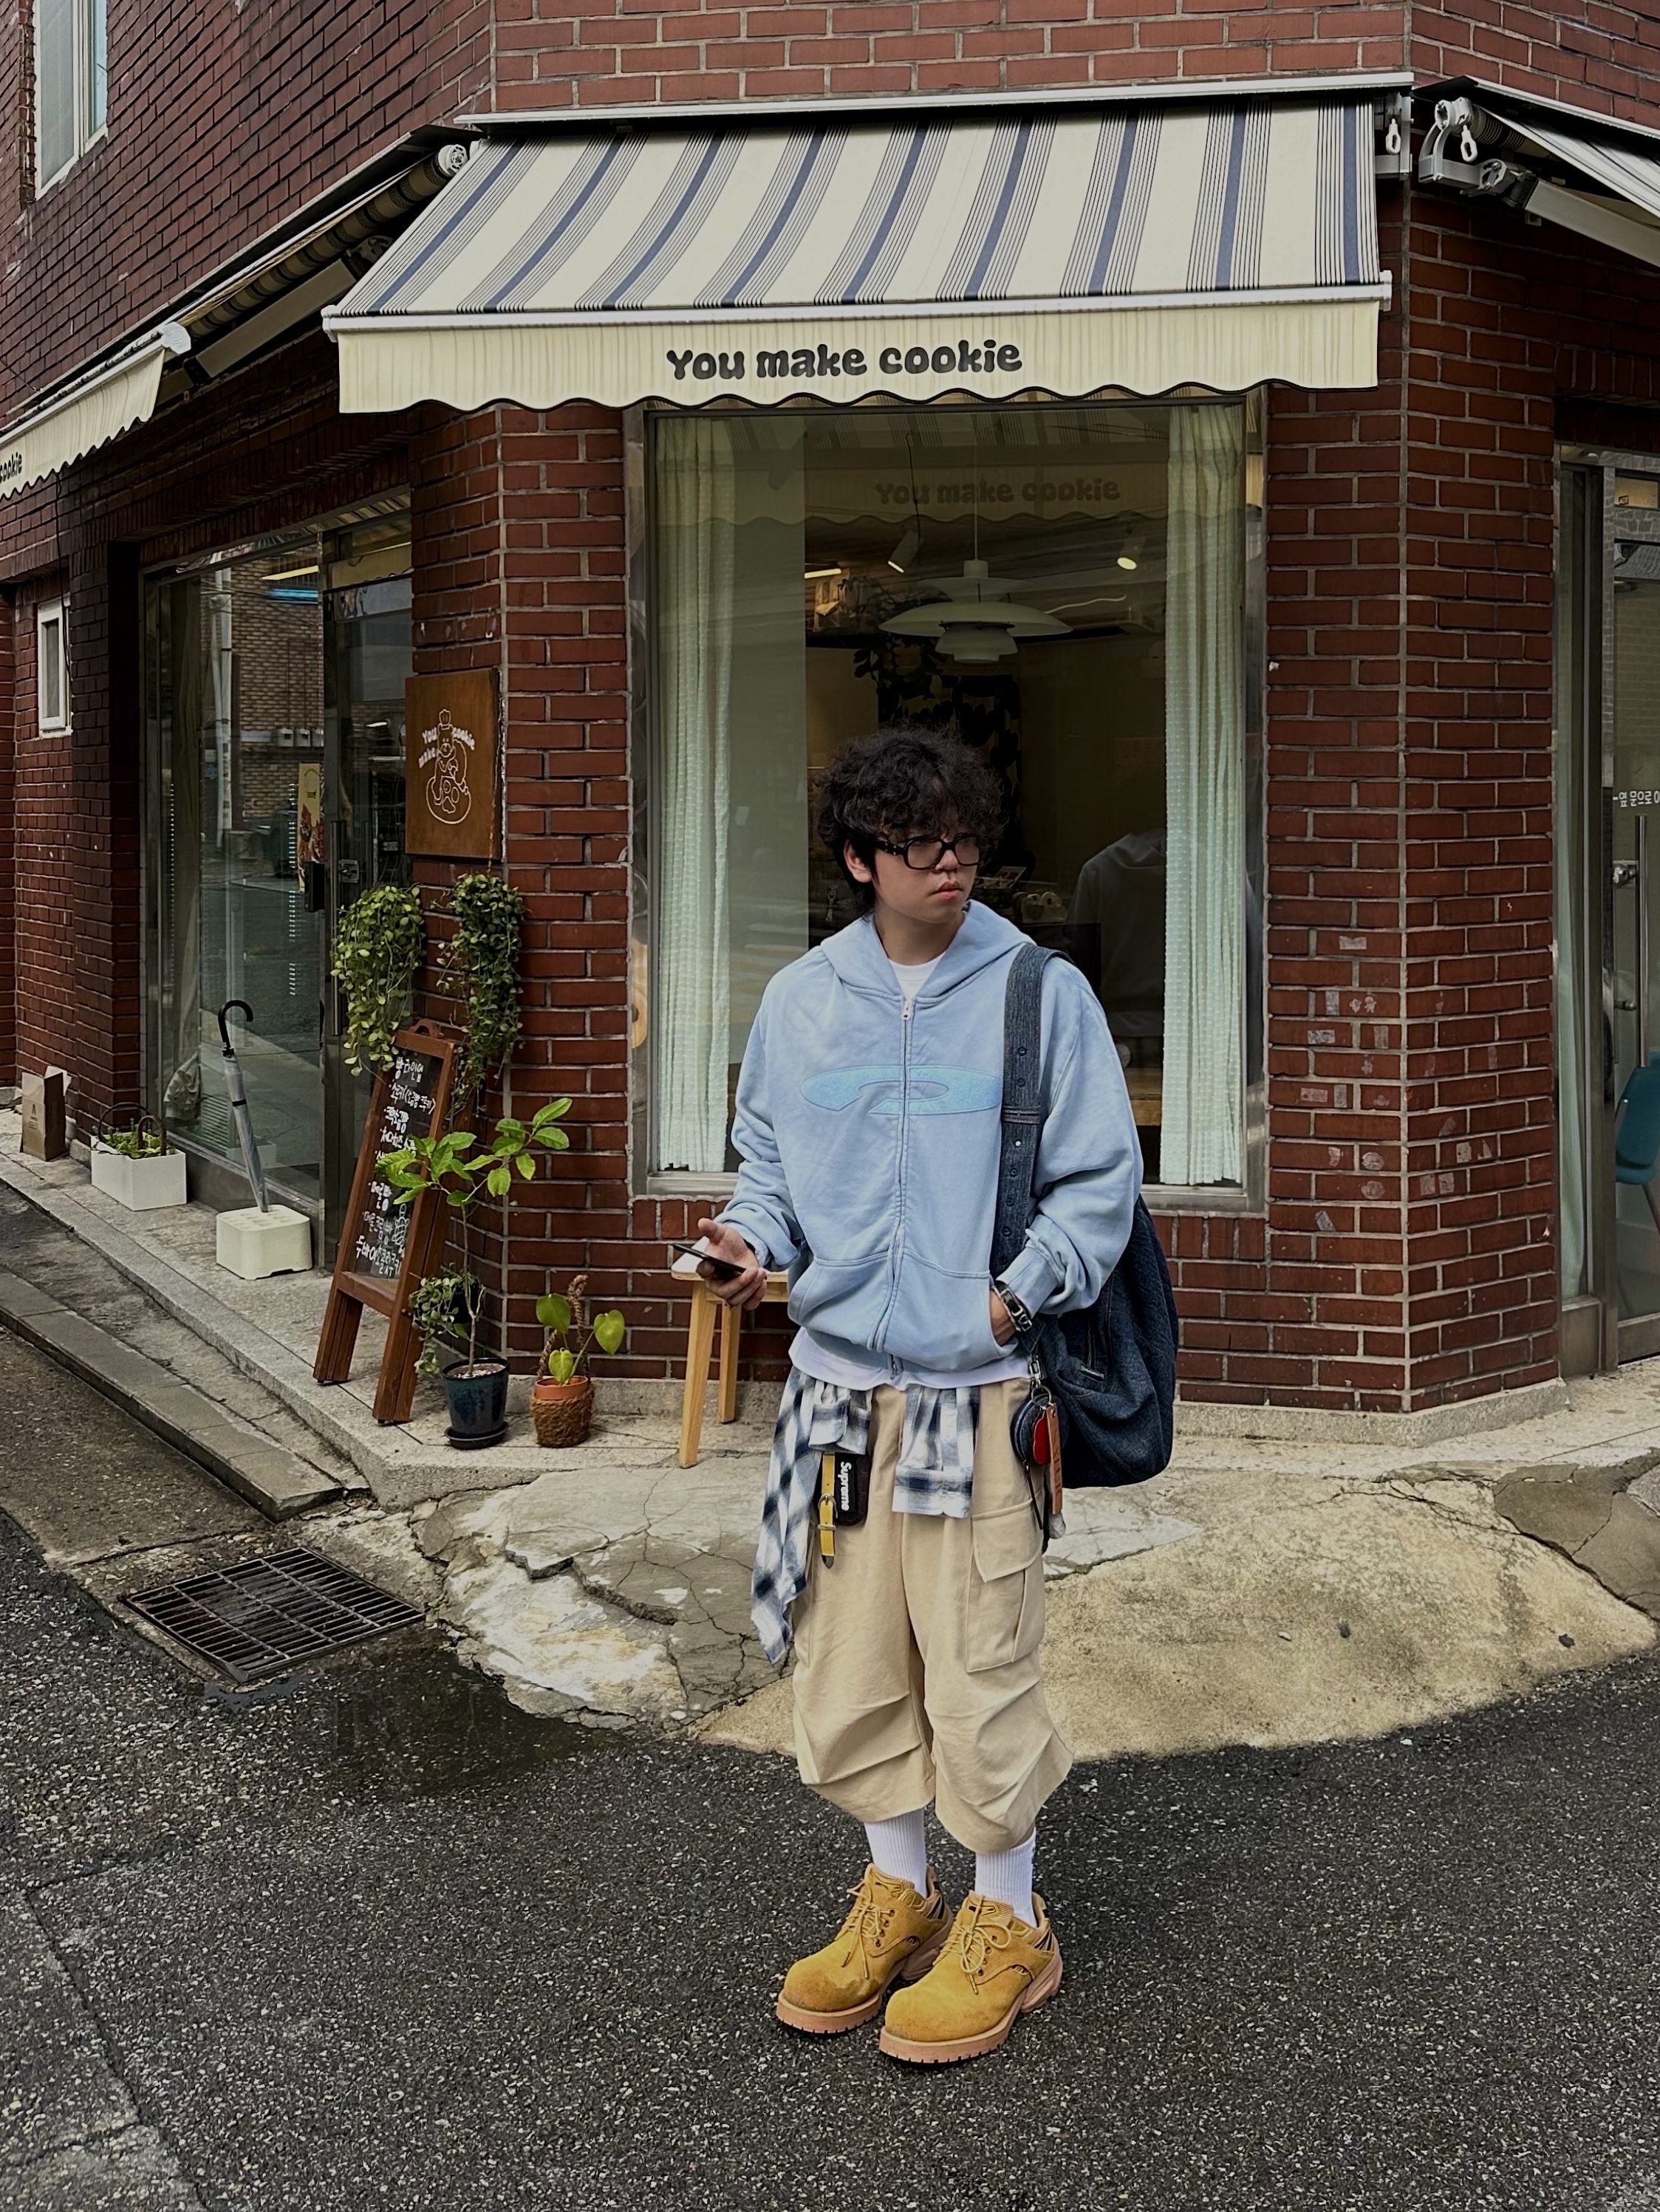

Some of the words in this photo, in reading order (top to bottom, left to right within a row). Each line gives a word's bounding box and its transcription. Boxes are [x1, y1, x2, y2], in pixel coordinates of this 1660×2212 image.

[666, 349, 745, 380] You
[756, 343, 867, 378] make
[879, 339, 1022, 375] cookie
[875, 482, 929, 504] You
[937, 479, 1014, 504] make
[1022, 478, 1121, 502] cookie
[422, 727, 437, 744] You
[452, 727, 475, 750] cookie
[418, 747, 436, 768] make
[1630, 791, 1652, 807] 문으로
[838, 1461, 852, 1511] Supreme
